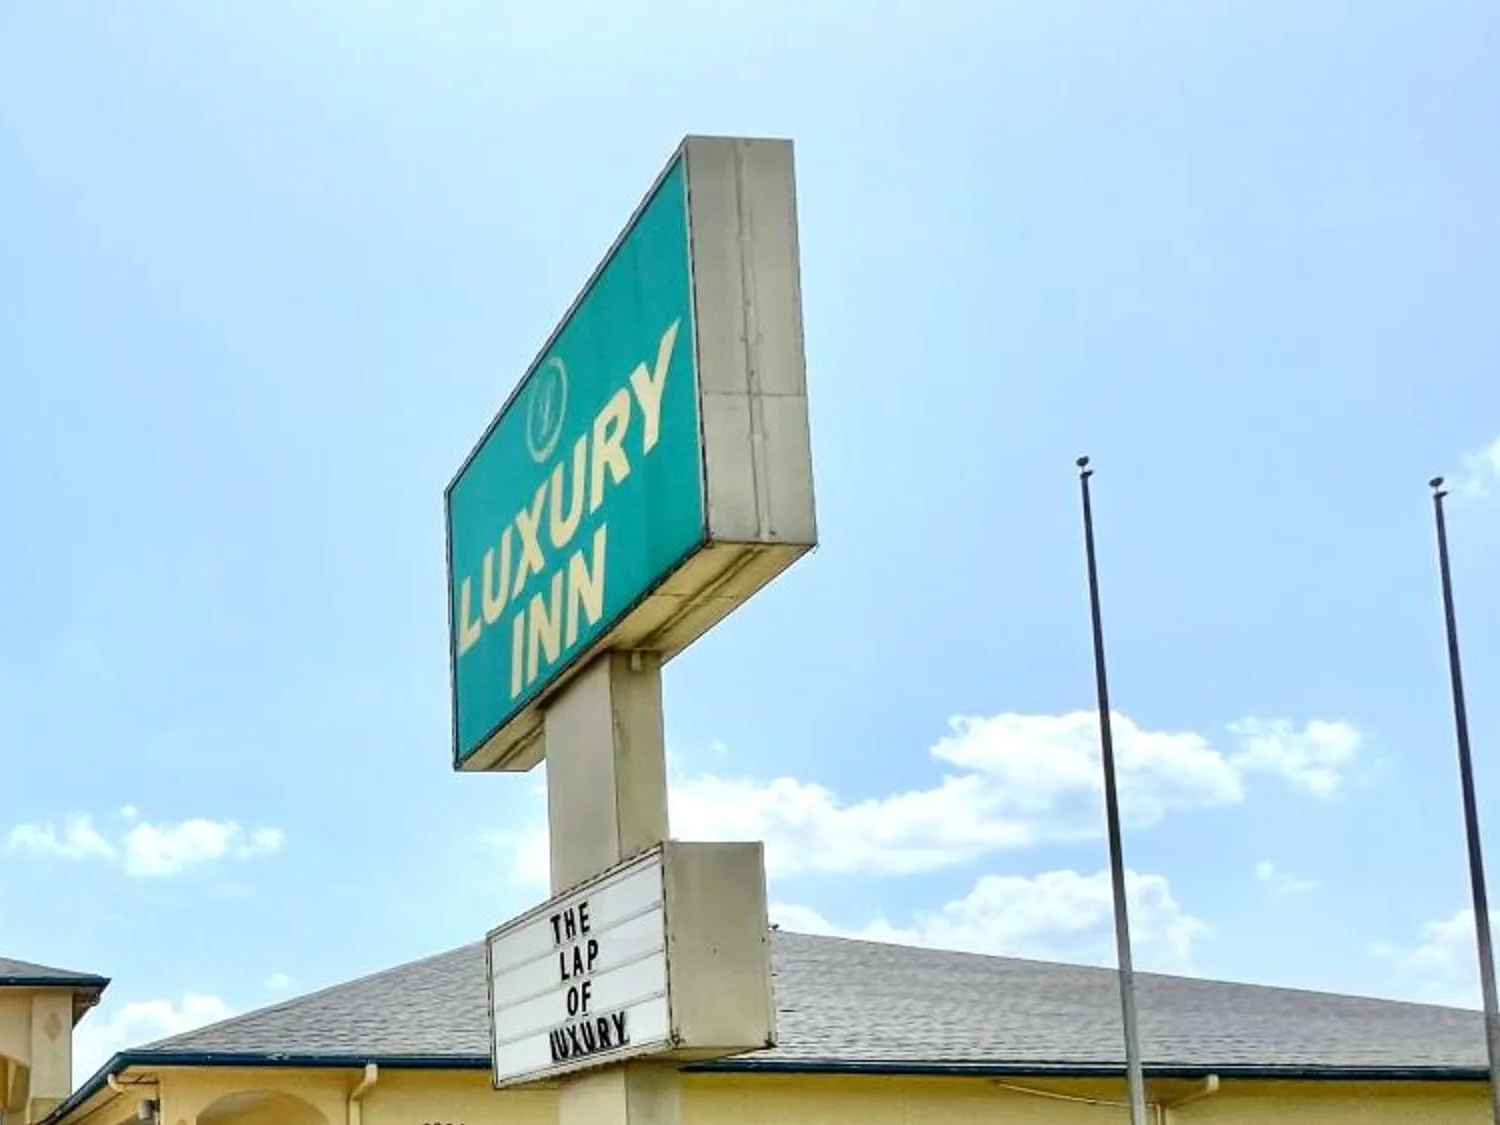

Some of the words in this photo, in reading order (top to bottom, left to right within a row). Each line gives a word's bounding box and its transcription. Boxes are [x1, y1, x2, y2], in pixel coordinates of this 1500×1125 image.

[459, 318, 681, 656] LUXURY
[511, 523, 609, 699] INN
[550, 901, 590, 944] THE
[559, 939, 599, 981] LAP
[567, 981, 592, 1016] OF
[549, 1011, 627, 1061] LUXURY
